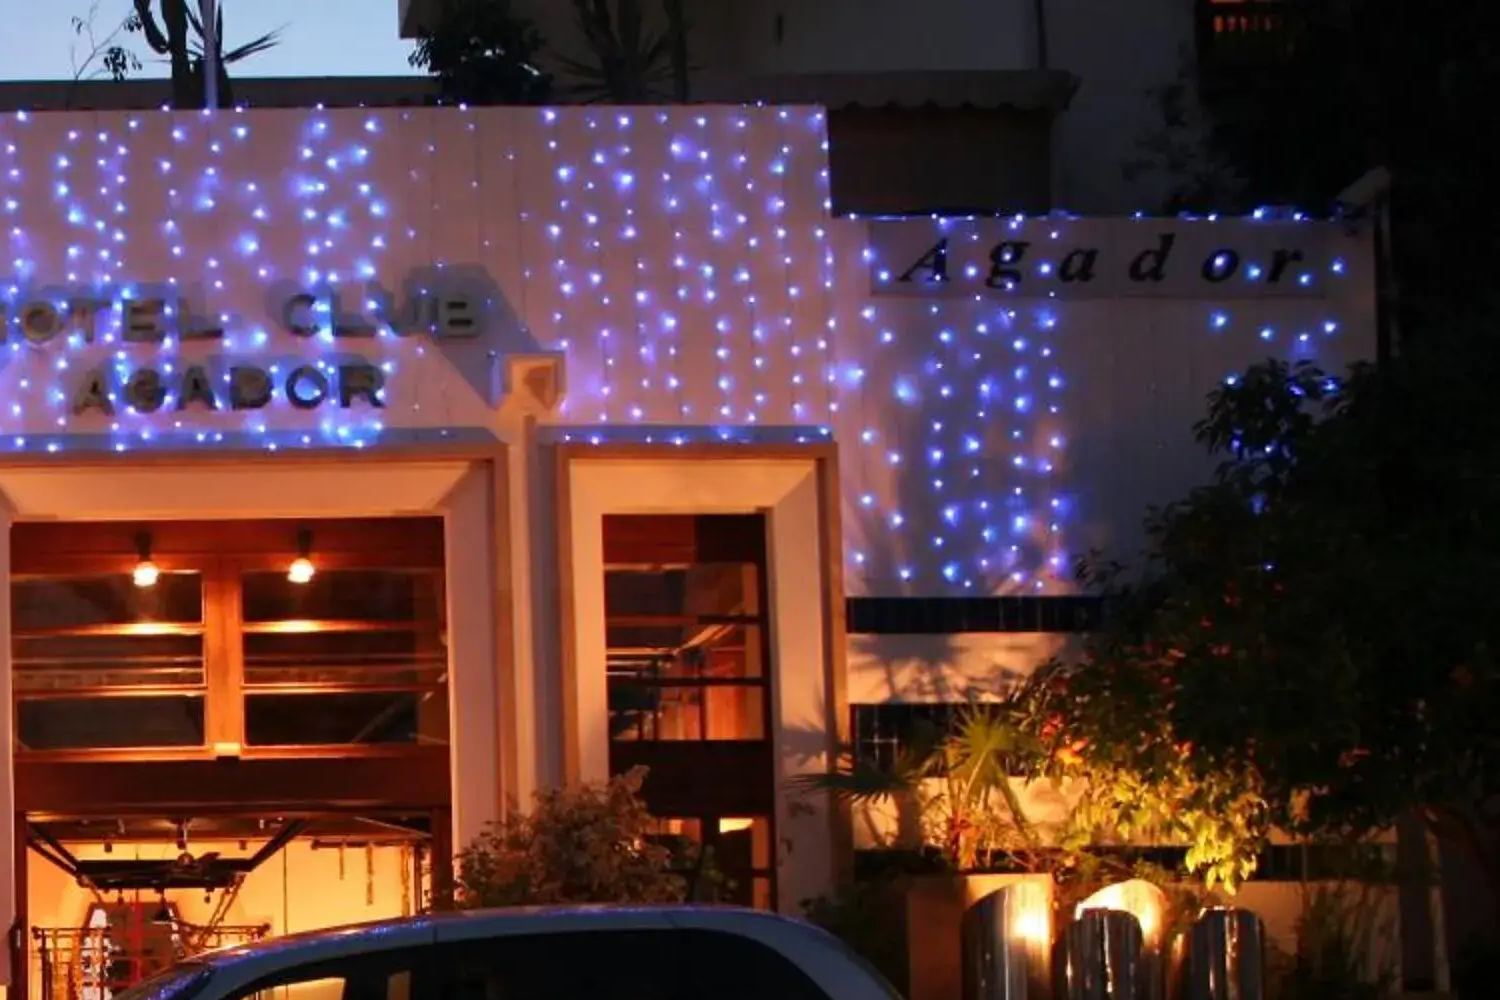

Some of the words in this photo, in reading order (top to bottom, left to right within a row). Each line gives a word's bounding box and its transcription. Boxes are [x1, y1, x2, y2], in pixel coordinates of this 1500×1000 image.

[897, 232, 1305, 290] Agador
[283, 293, 482, 341] CLUB
[72, 365, 385, 416] AGADOR
